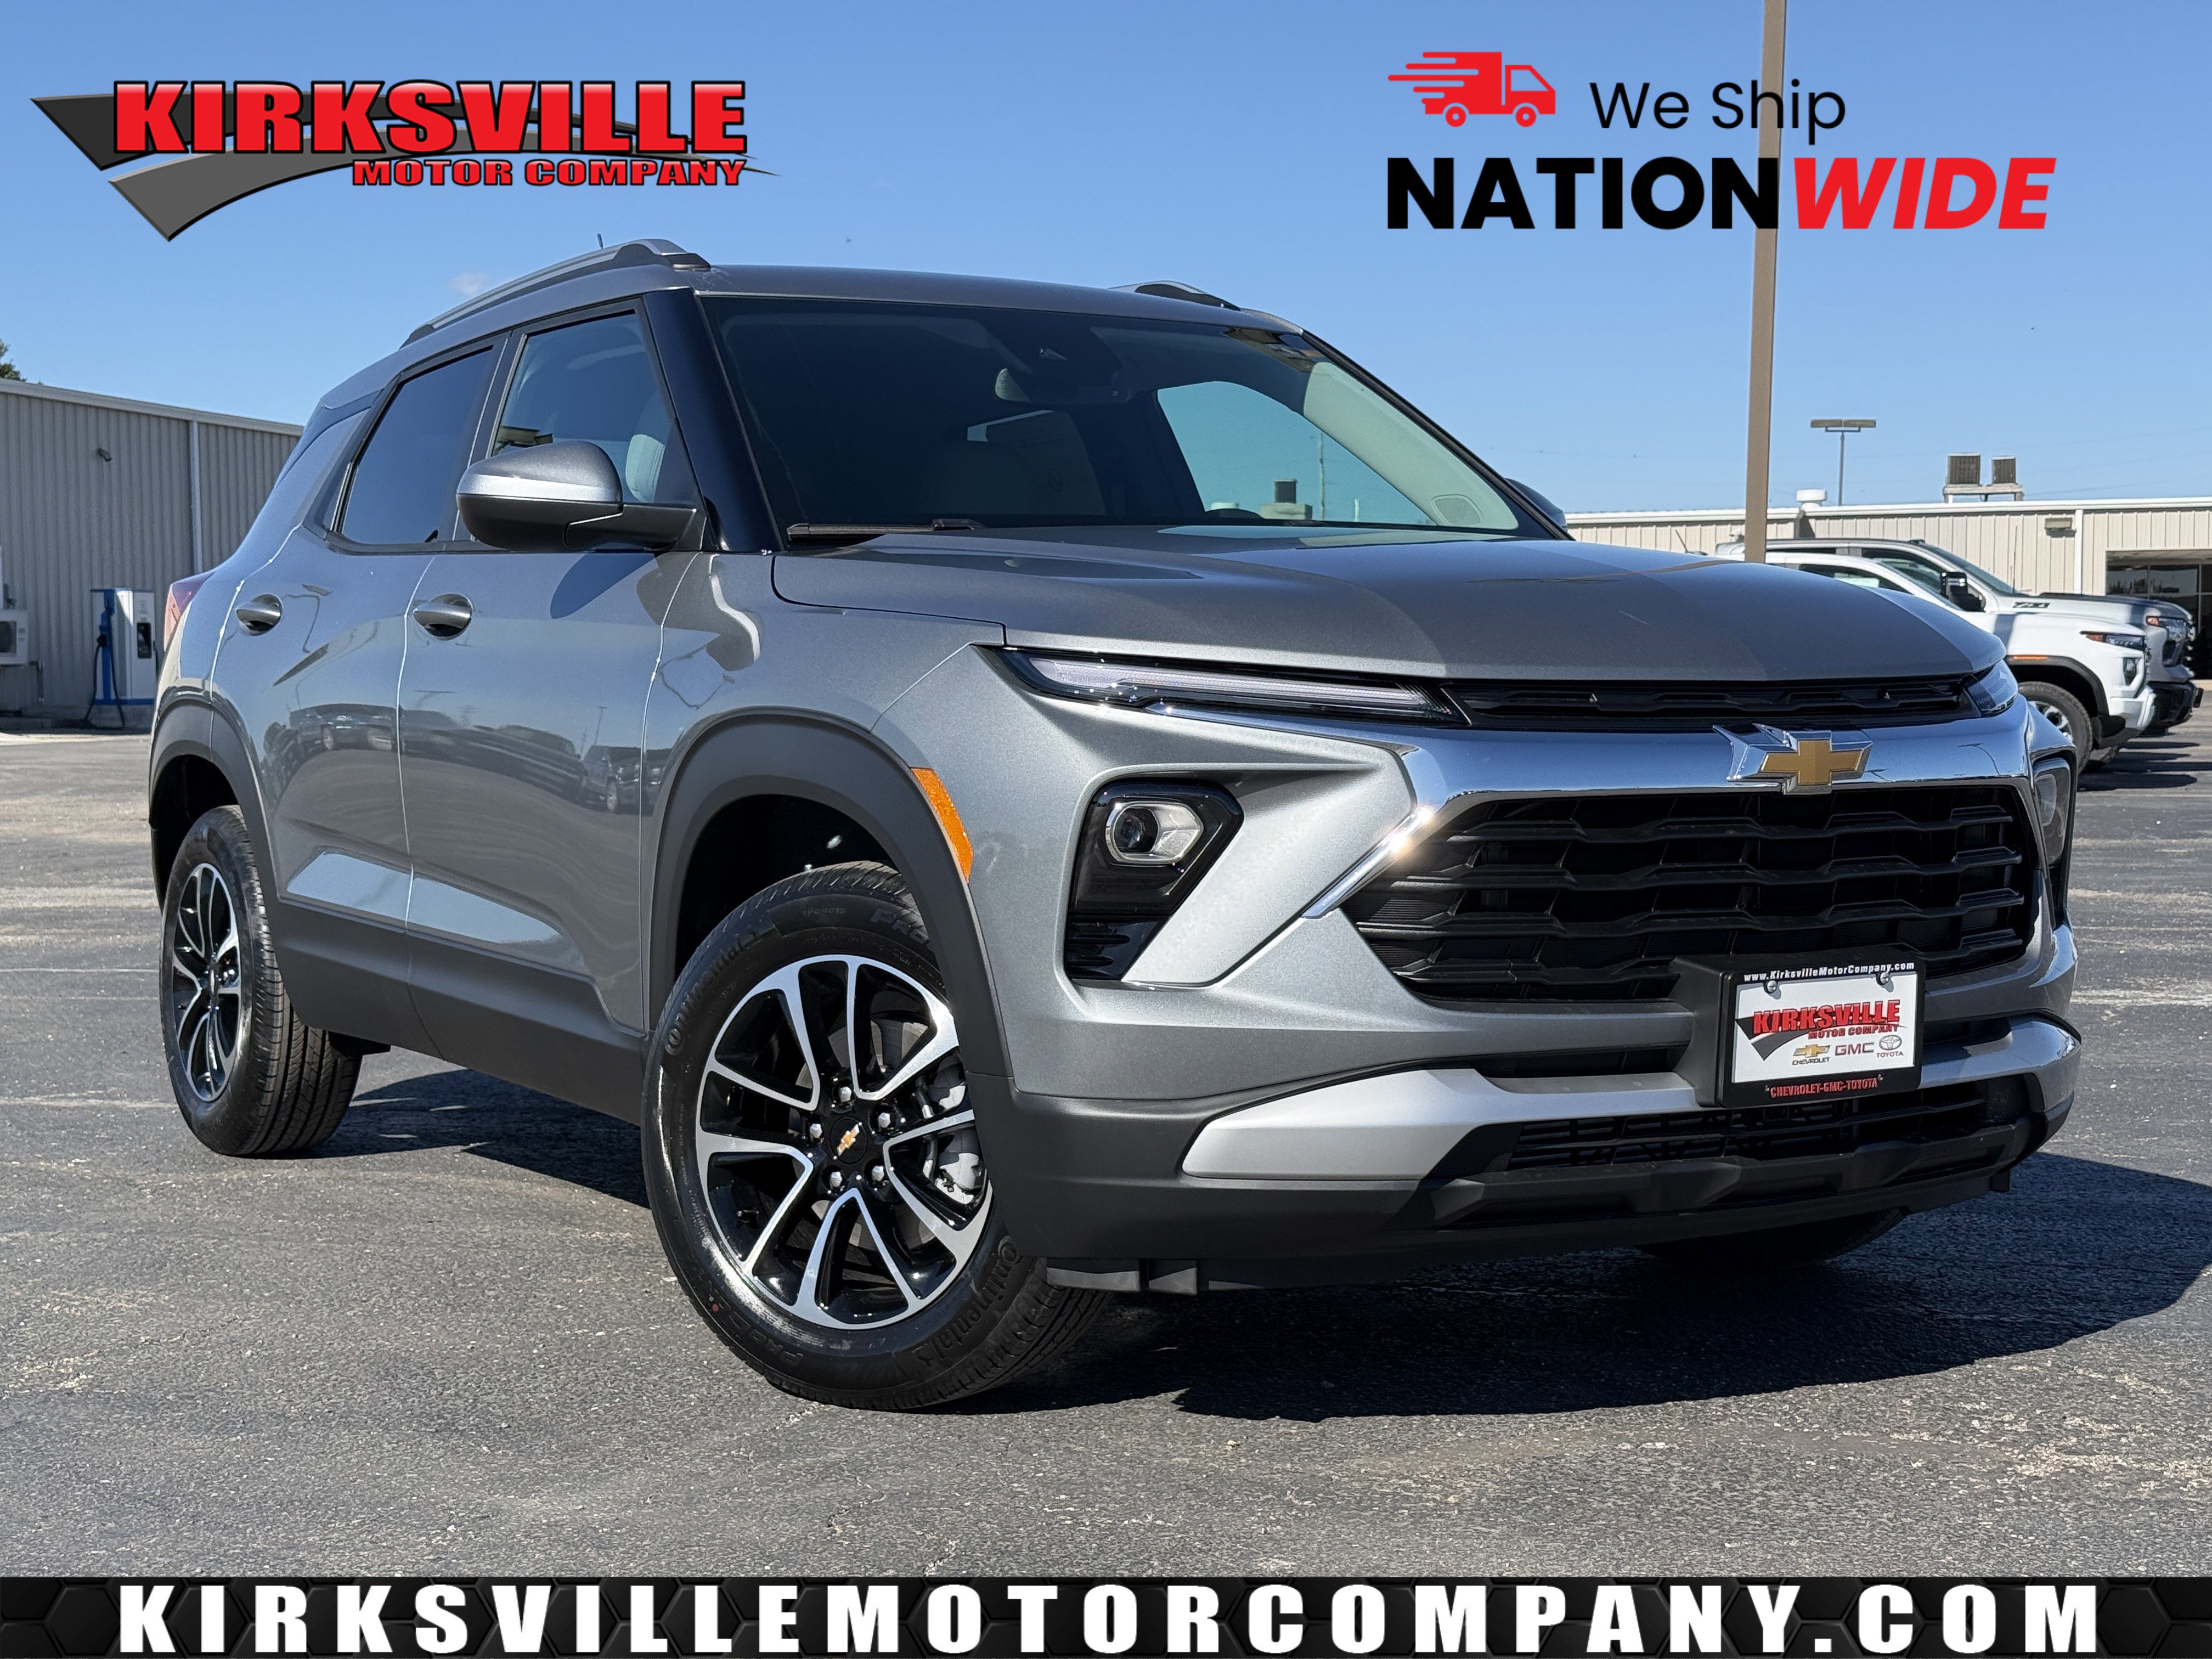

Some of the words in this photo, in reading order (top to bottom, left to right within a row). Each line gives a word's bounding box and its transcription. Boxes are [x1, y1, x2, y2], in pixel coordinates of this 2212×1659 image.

[1743, 962, 1915, 982] www.KirksvilleMotorCompany.com
[1753, 999, 1900, 1035] KIRKSVILLE
[1808, 1029, 1846, 1040] MOTOR
[1848, 1024, 1900, 1035] COMPANY
[1835, 1042, 1875, 1056] GMC
[1792, 1057, 1830, 1065] CHEVROLET
[1770, 1077, 1878, 1098] CHEVROLET-GMC-TOYOTA
